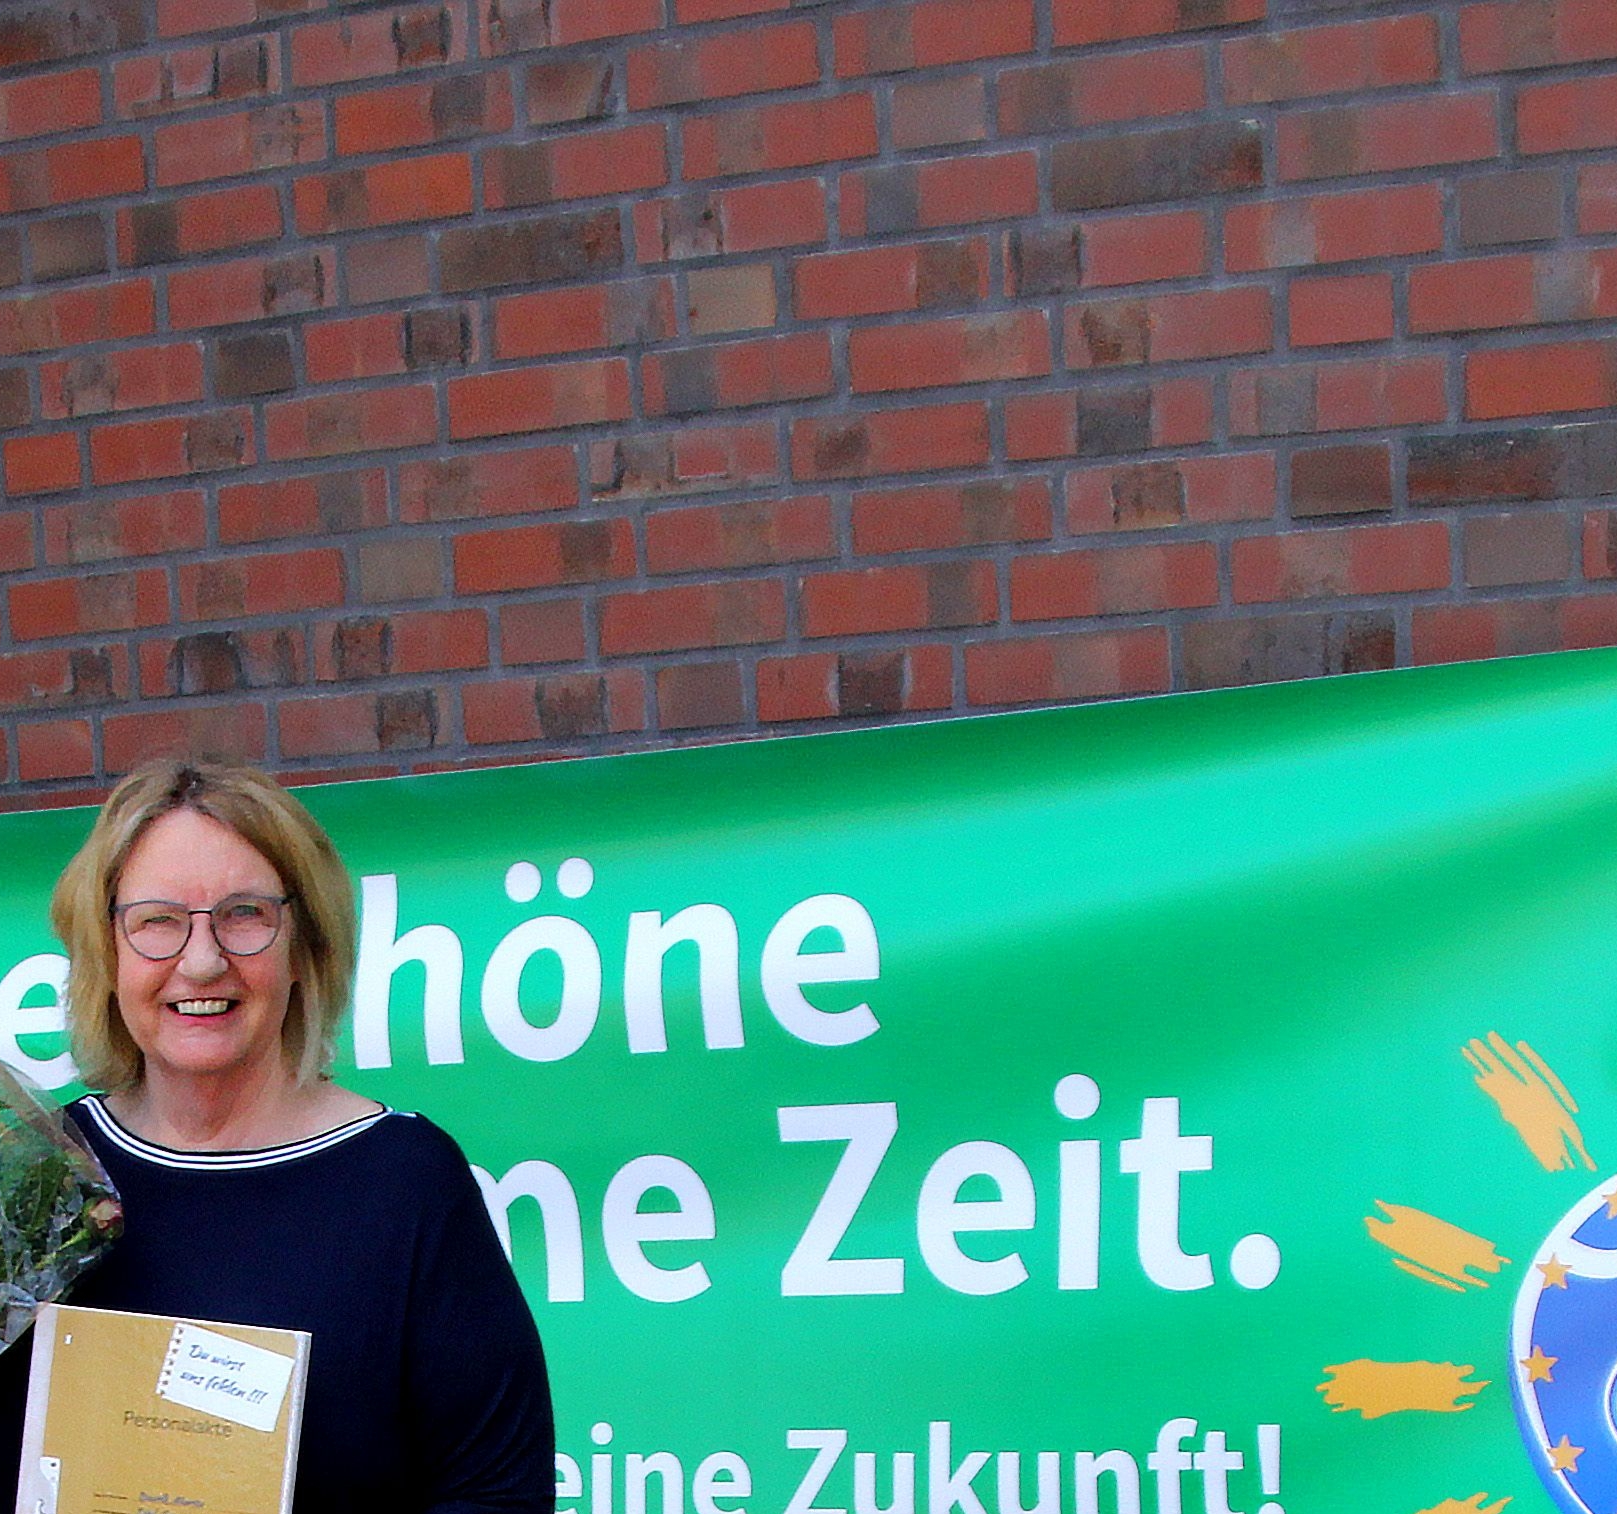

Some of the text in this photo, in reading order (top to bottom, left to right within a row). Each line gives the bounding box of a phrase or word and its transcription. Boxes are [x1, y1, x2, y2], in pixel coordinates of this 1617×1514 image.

[352, 857, 882, 1070] höne
[775, 1073, 1282, 1297] Zeit.
[123, 1410, 232, 1438] Personalakte
